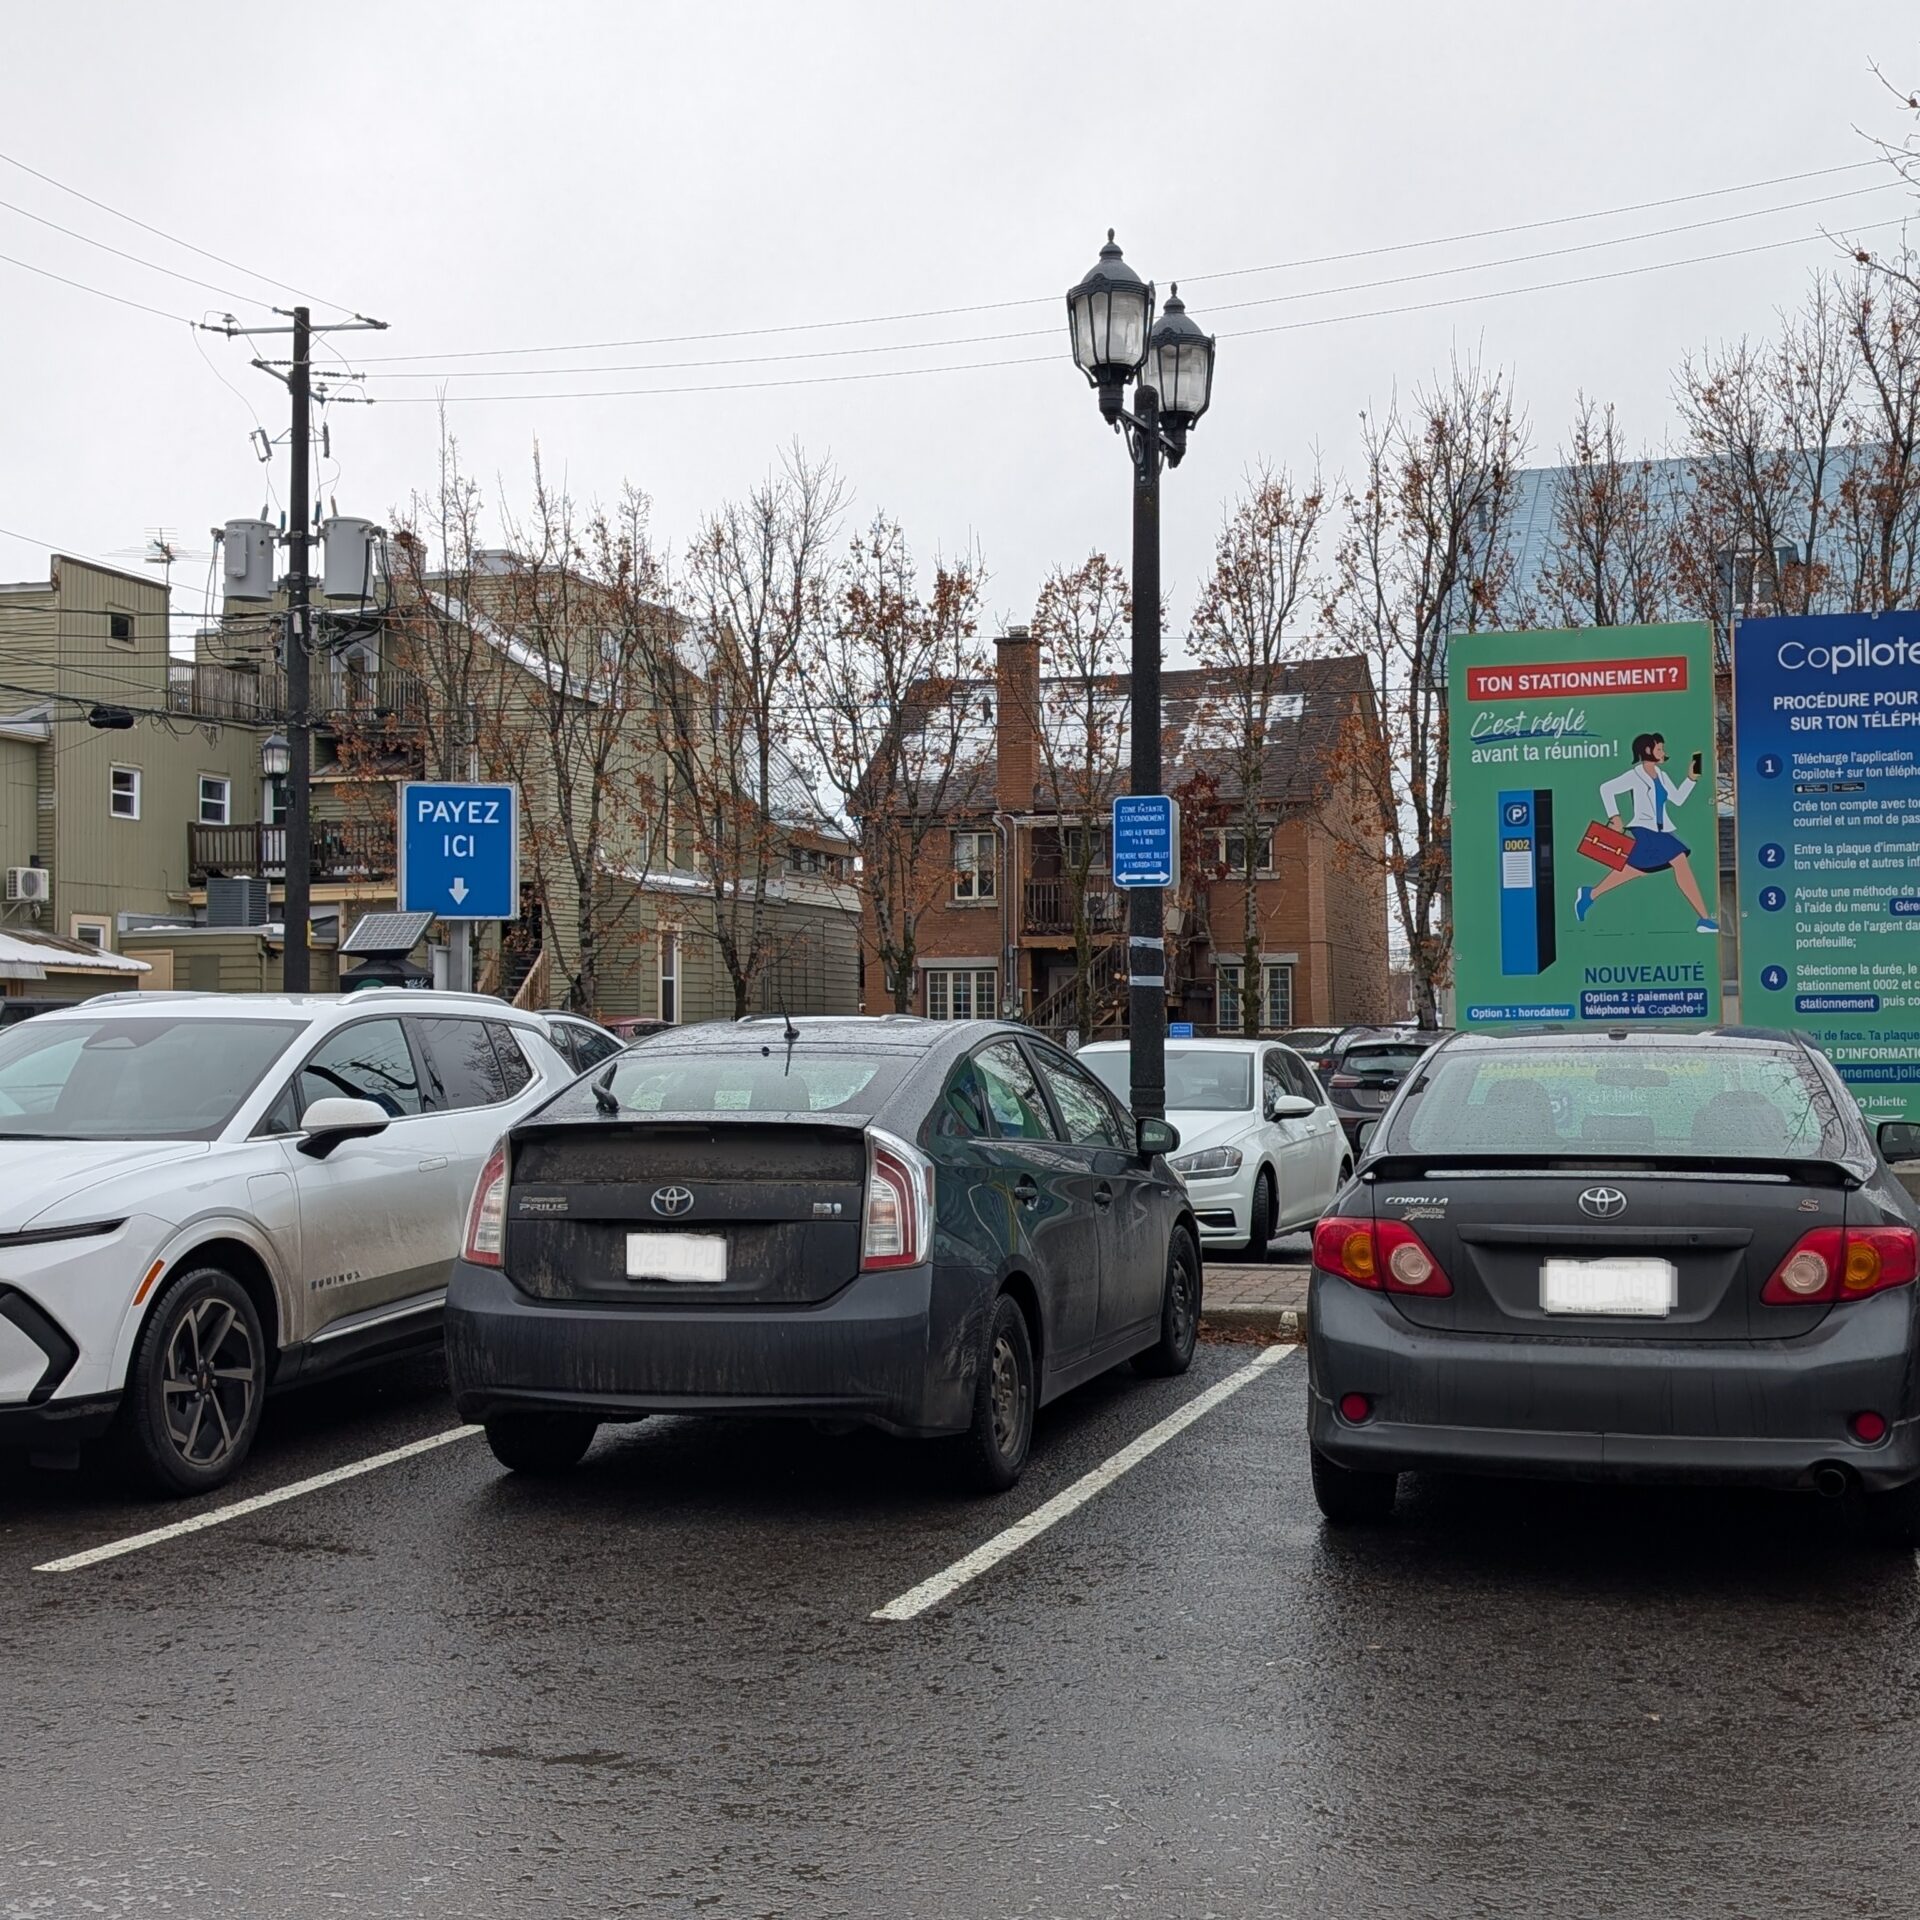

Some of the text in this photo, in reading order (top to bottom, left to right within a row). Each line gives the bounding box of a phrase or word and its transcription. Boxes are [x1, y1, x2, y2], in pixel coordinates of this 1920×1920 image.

[1477, 676, 1513, 693] TON
[1773, 691, 1918, 711] PROCÉDURE POUR
[1470, 708, 1586, 739] C'est réglé
[1790, 716, 1823, 731] SUR
[1826, 715, 1858, 730] TON
[1471, 745, 1518, 763] avant
[1524, 744, 1539, 761] ta
[1792, 749, 1913, 766] Télécharge l'application
[1765, 759, 1774, 773] 1
[1792, 767, 1844, 781] Copilote+
[1847, 768, 1863, 778] sur
[1866, 767, 1883, 778] ton
[418, 800, 499, 823] PAYEZ
[1793, 800, 1818, 812] Crée
[1820, 800, 1837, 811] ton
[1839, 800, 1878, 812] compte
[1881, 800, 1905, 810] avec
[1793, 815, 1832, 827] courriel
[1834, 815, 1845, 826] et
[1847, 816, 1861, 826] un
[1864, 814, 1883, 825] mot
[1885, 813, 1899, 824] de
[444, 834, 474, 857] ICI
[1504, 839, 1530, 851] 0002
[1794, 844, 1822, 855] Entre
[1824, 843, 1834, 854] la
[1836, 842, 1871, 856] plaque
[1767, 849, 1776, 862] 2
[1794, 859, 1811, 870] ton
[1814, 857, 1857, 869] véhicule
[1859, 859, 1870, 868] et
[1872, 858, 1904, 868] autres
[1767, 892, 1777, 905] 3
[1795, 887, 1828, 900] Ajoute
[1831, 888, 1850, 897] une
[1853, 885, 1898, 897] méthode
[1901, 885, 1914, 896] de
[1795, 903, 1802, 913] à
[1804, 902, 1832, 913] l'aide
[1835, 901, 1848, 912] du
[1851, 902, 1880, 912] menu
[1796, 922, 1811, 933] Ou
[1814, 921, 1846, 934] ajoute
[1848, 921, 1861, 932] de
[1864, 920, 1903, 934] l'argent
[1796, 936, 1857, 950] portefeuille;
[1584, 961, 1704, 984] NOUVEAUTÉ
[1797, 963, 1917, 976] Sélectionne la durée, le
[1769, 971, 1778, 984] 4
[1797, 980, 1871, 991] stationnement
[1873, 979, 1898, 990] 0002
[1901, 979, 1912, 989] et
[1585, 991, 1619, 1004] Option
[1621, 992, 1628, 1002] 2
[1637, 991, 1684, 1003] paiement
[1687, 991, 1704, 1003] par
[1800, 998, 1875, 1009] stationnement
[1883, 995, 1905, 1008] puis
[1471, 1008, 1503, 1020] Option
[1505, 1008, 1510, 1018] 1
[1518, 1007, 1570, 1018] horodateur
[1585, 1004, 1629, 1016] téléphone
[1631, 1004, 1645, 1014] via
[1825, 1030, 1837, 1040] de
[1840, 1030, 1865, 1040] face.
[1868, 1030, 1881, 1040] Ta
[1883, 1030, 1920, 1042] plaque
[1869, 1095, 1909, 1109] Joliette
[519, 1203, 569, 1211] PRIUS
[1385, 1197, 1449, 1205] COROLLA
